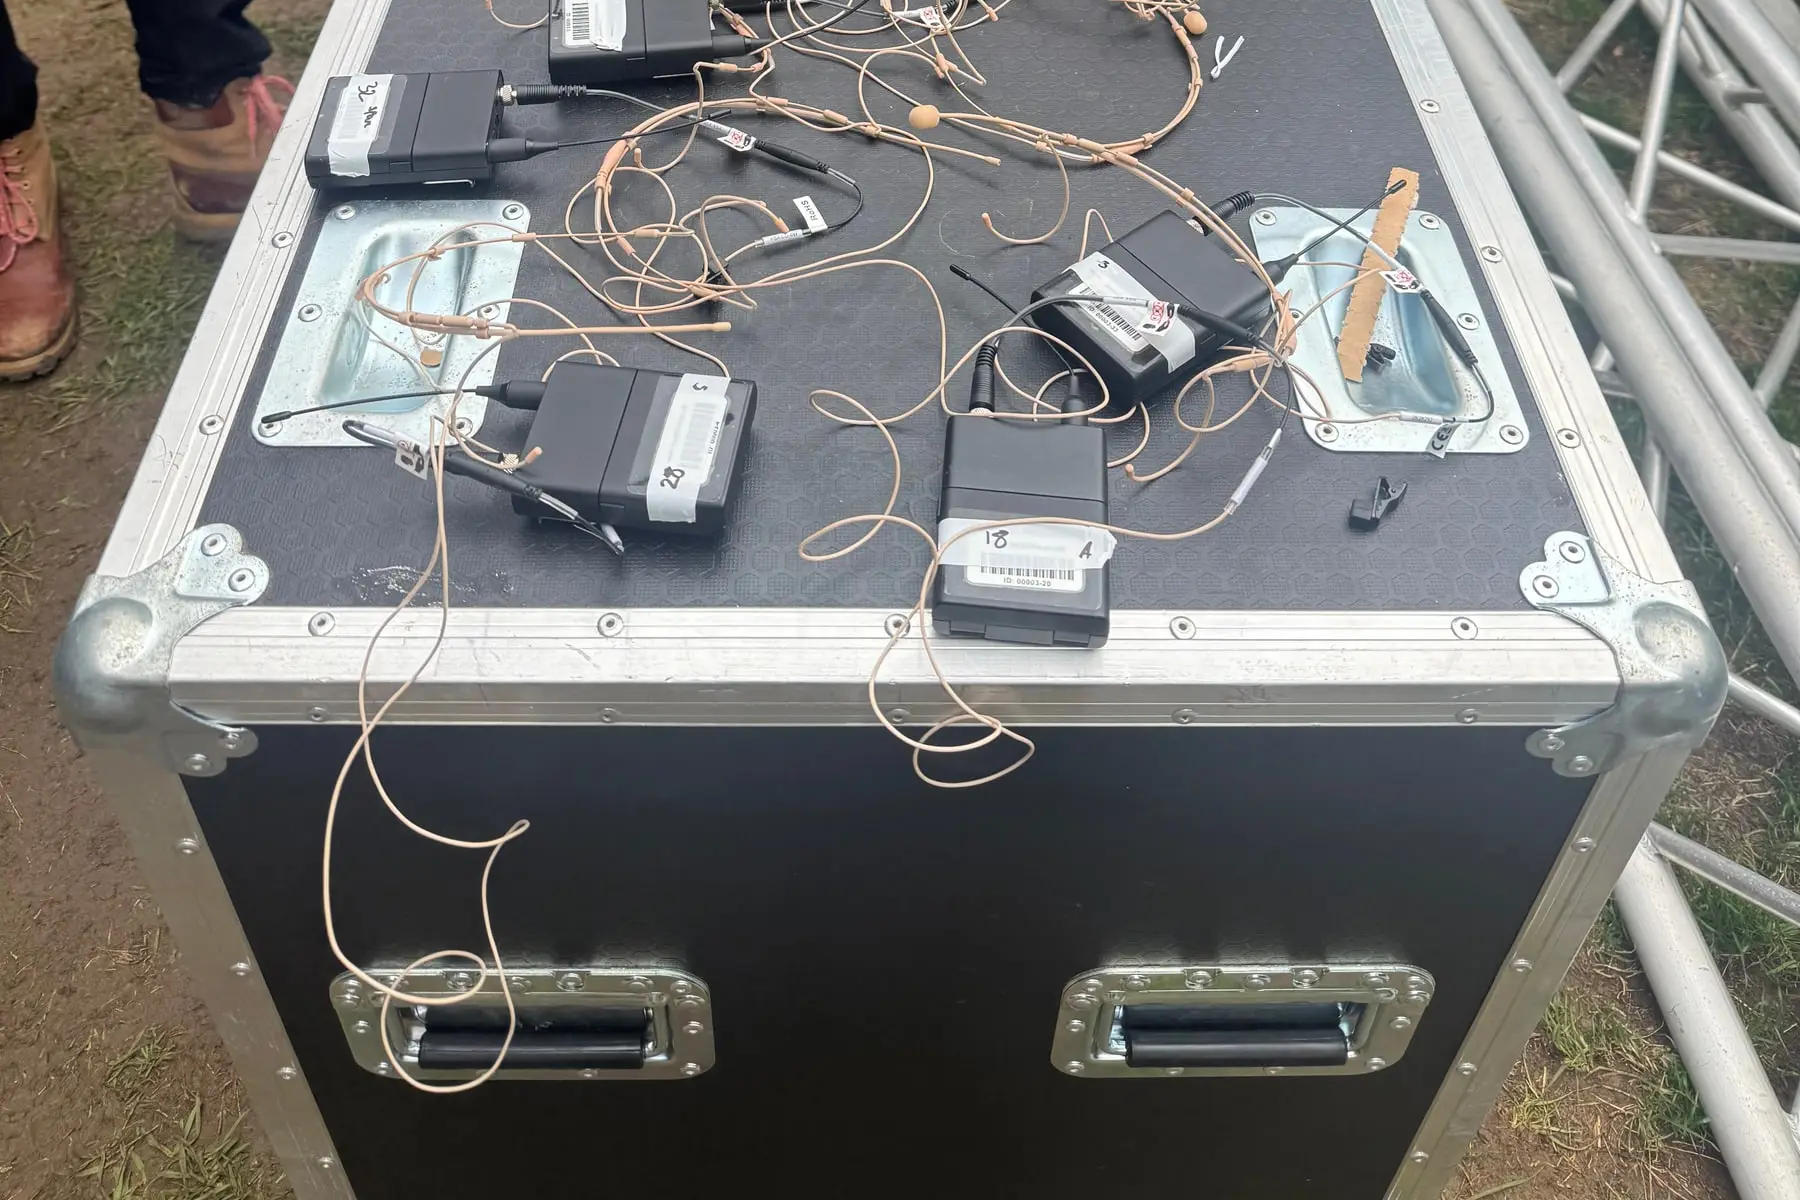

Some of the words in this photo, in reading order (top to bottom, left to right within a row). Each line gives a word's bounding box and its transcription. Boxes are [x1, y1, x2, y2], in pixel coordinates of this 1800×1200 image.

[801, 200, 818, 221] RoHS
[659, 466, 686, 490] 28
[986, 529, 1010, 549] 18
[1078, 541, 1093, 559] A
[1016, 578, 1052, 587] 00003-20
